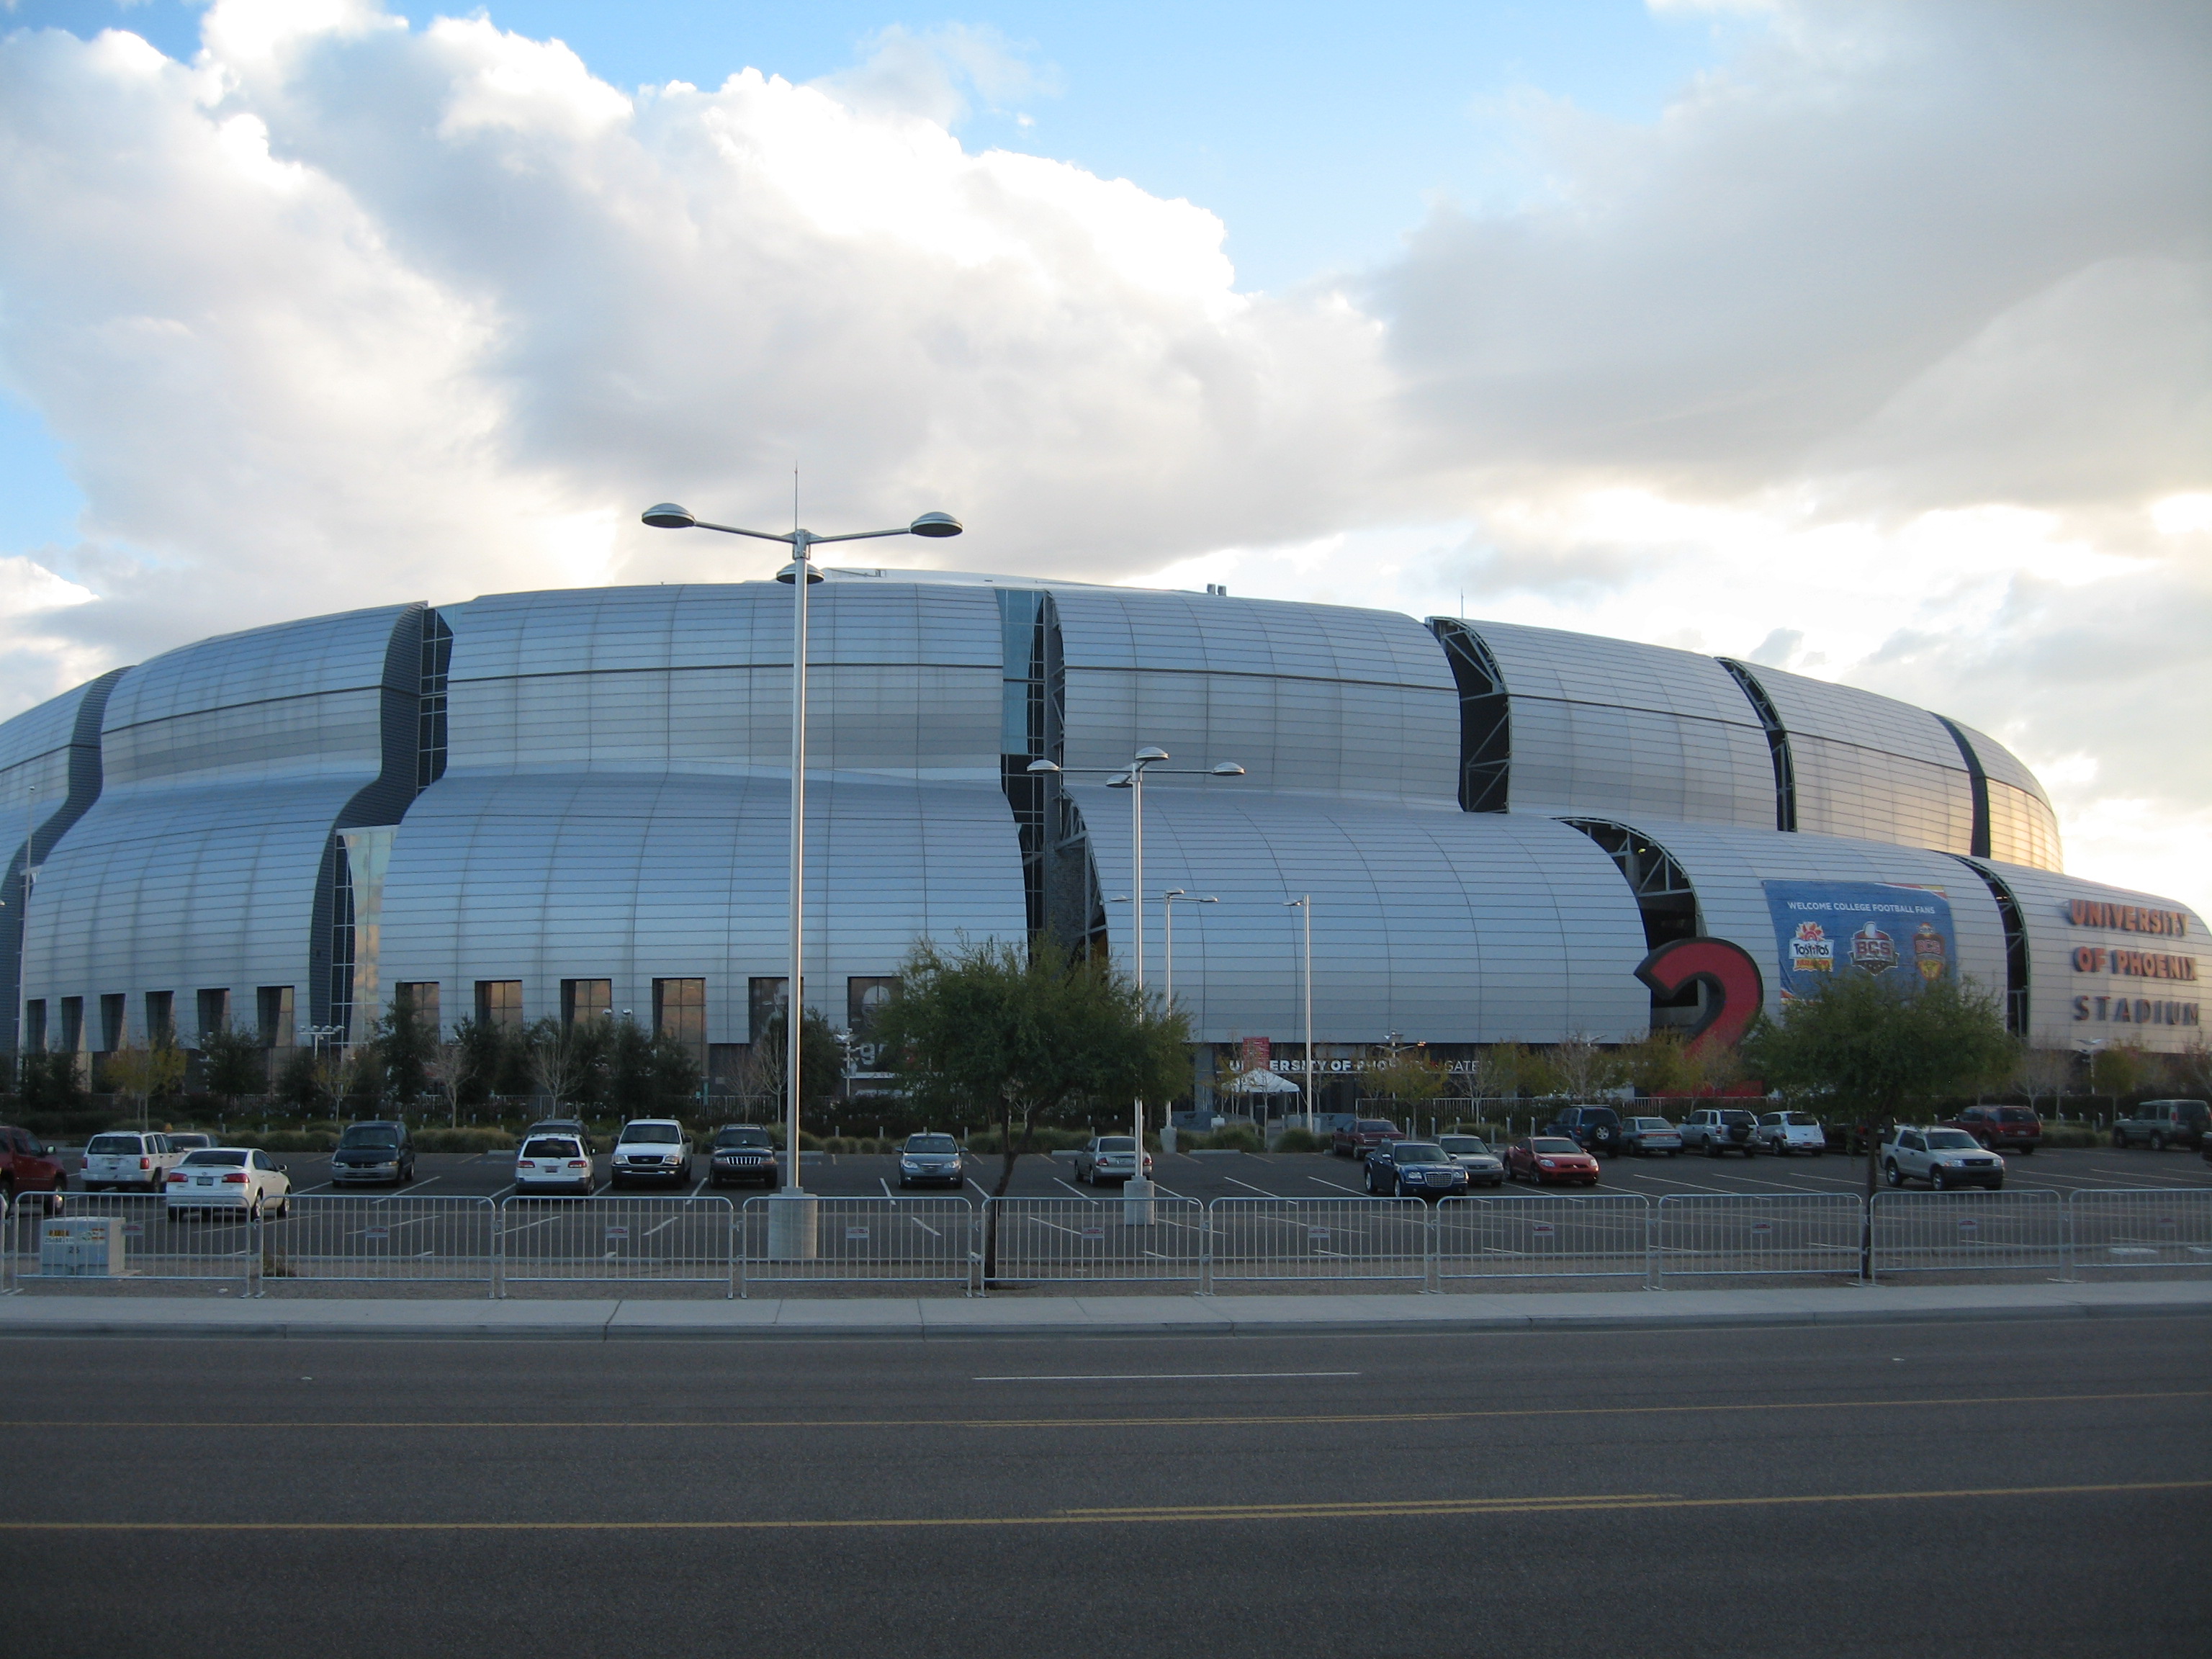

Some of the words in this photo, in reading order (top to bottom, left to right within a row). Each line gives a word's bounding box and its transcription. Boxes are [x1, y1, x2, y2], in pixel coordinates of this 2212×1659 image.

[1787, 901, 1832, 911] WELCOME
[1833, 902, 1871, 912] COLLEGE
[1872, 904, 1915, 913] FOOTBALL
[1915, 906, 1936, 914] FANS
[2069, 899, 2189, 936] UNIVERSITY
[1855, 940, 1890, 955] BCS
[2073, 946, 2106, 972] OF
[2111, 949, 2198, 981] PHOENIX
[2074, 995, 2198, 1025] STADIUM
[1229, 1060, 1328, 1071] UERSITY
[1330, 1059, 1352, 1071] OF
[1444, 1060, 1480, 1071] GATE
